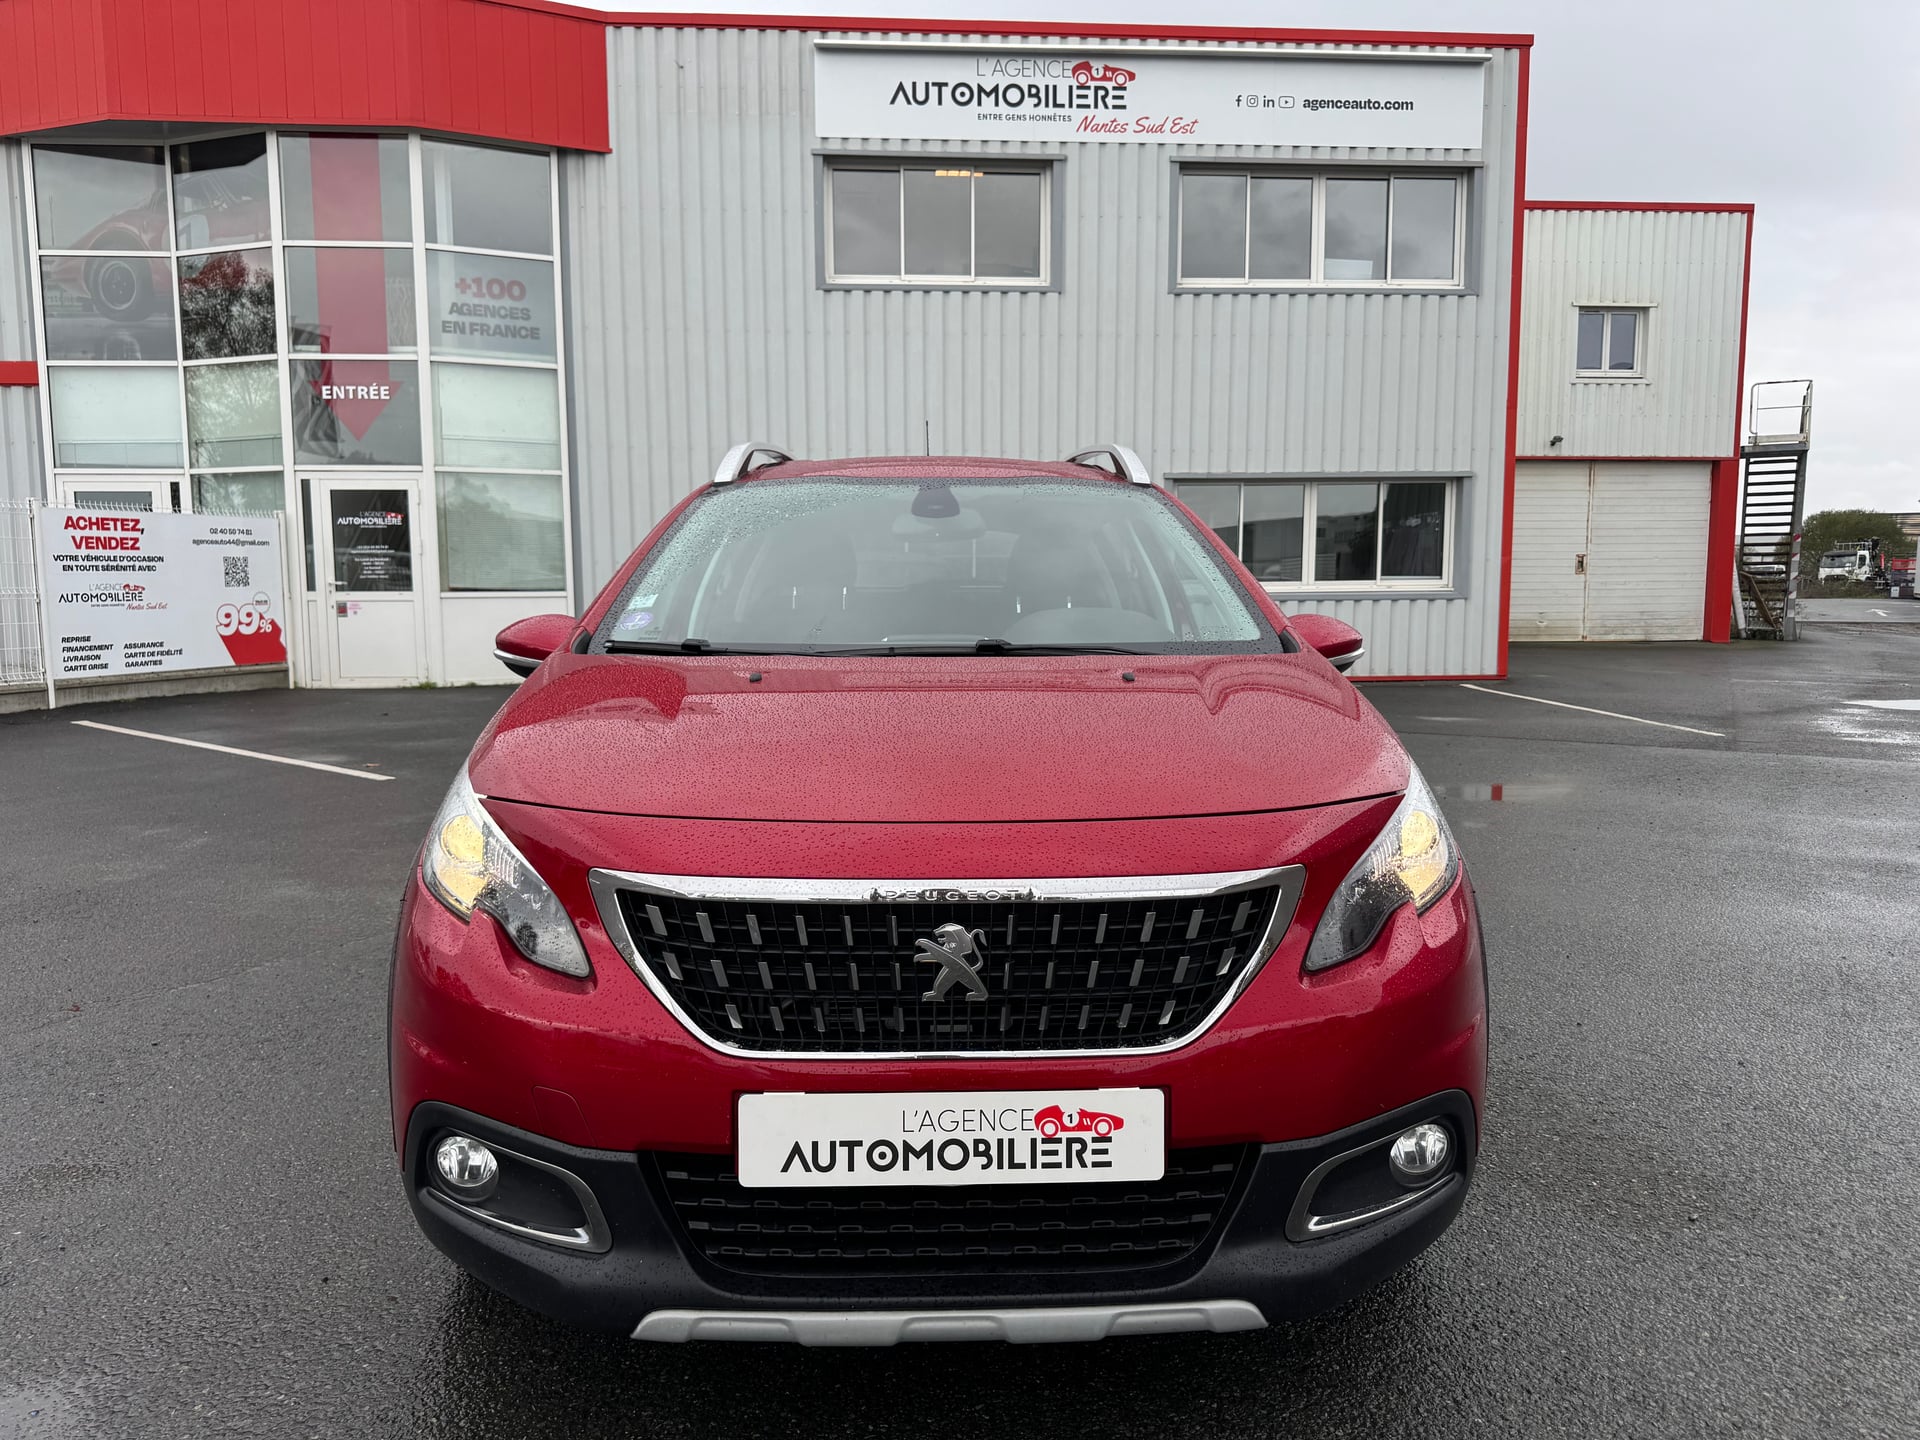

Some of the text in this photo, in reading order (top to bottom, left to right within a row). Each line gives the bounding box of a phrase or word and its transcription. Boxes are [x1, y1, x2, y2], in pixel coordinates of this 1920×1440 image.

[976, 57, 1072, 79] L'AGENCE
[1095, 67, 1100, 76] 1
[1302, 98, 1414, 111] agenceauto.com
[977, 112, 1072, 122] ENTRE GENS HONNÊTES
[1076, 115, 1200, 135] Nantes Sud Est
[455, 276, 526, 302] +100
[448, 302, 531, 321] AGENCES
[442, 320, 541, 340] EN FRANCE
[321, 383, 390, 400] ENTRÉE
[64, 516, 144, 535] ACHETEZ,
[71, 535, 140, 550] VENDEZ
[53, 553, 164, 563] VOTRE VÉHICULE D'OCCASION
[62, 563, 157, 572] EN TOUTE SÉRÉNITÉ AVEC
[88, 583, 123, 592] L'AGENCE
[62, 644, 114, 653] FINANCEMENT
[123, 641, 165, 650] ASSURANCE
[63, 654, 101, 663] LIVRAISON
[124, 651, 146, 659] CARTE
[157, 648, 183, 657] FIDÉLITÉ
[64, 663, 109, 672] CARTE GRISE
[125, 659, 163, 668] GARANTIES
[885, 888, 1019, 900] PEUGEOT
[902, 1108, 1035, 1133] L'AGENCE
[1067, 1113, 1073, 1124] 1
